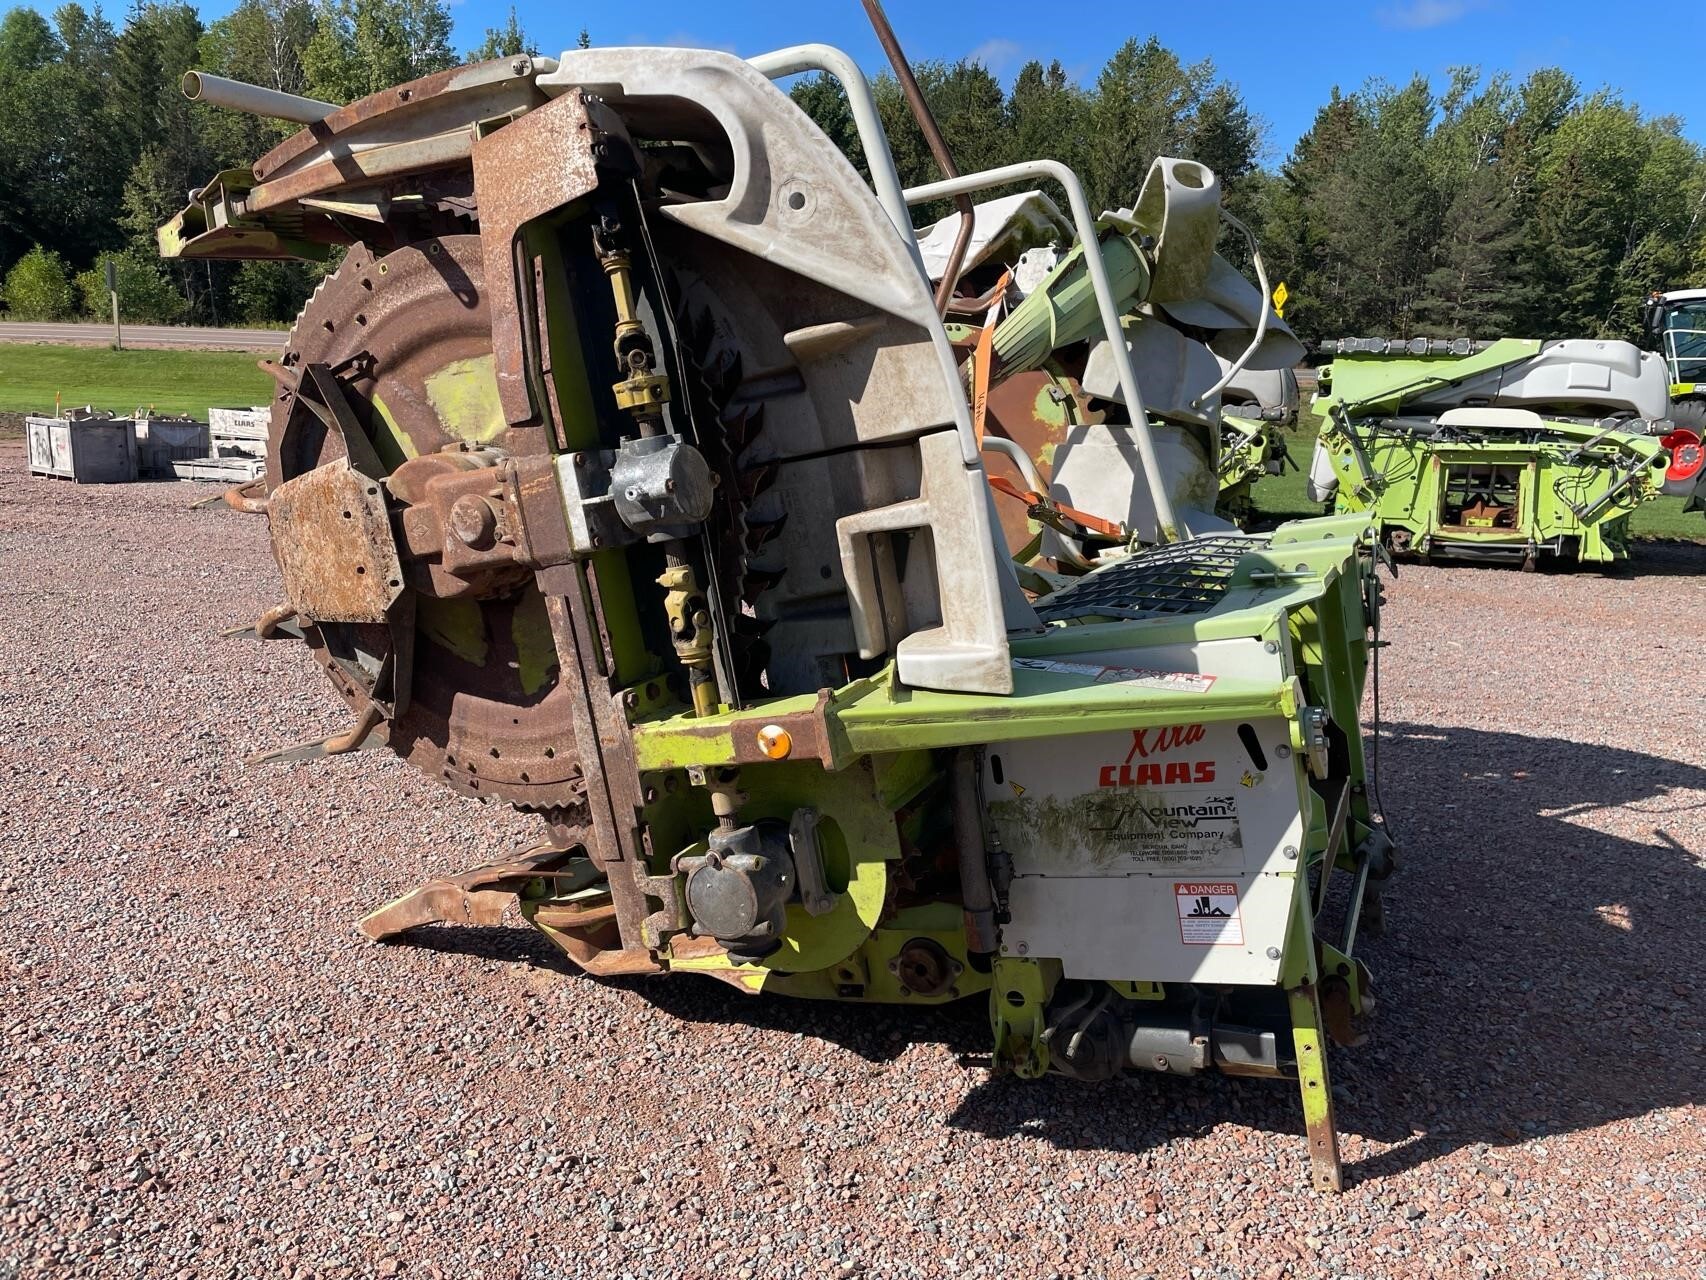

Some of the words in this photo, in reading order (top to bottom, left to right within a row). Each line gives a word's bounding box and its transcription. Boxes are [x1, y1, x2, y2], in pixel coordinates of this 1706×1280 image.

[1125, 724, 1206, 764] Xtra
[1099, 761, 1216, 787] CLAAS
[1115, 801, 1227, 825] Mountain
[1106, 830, 1166, 841] Equipment
[1169, 829, 1225, 841] Company
[1190, 885, 1234, 894] DANGER
